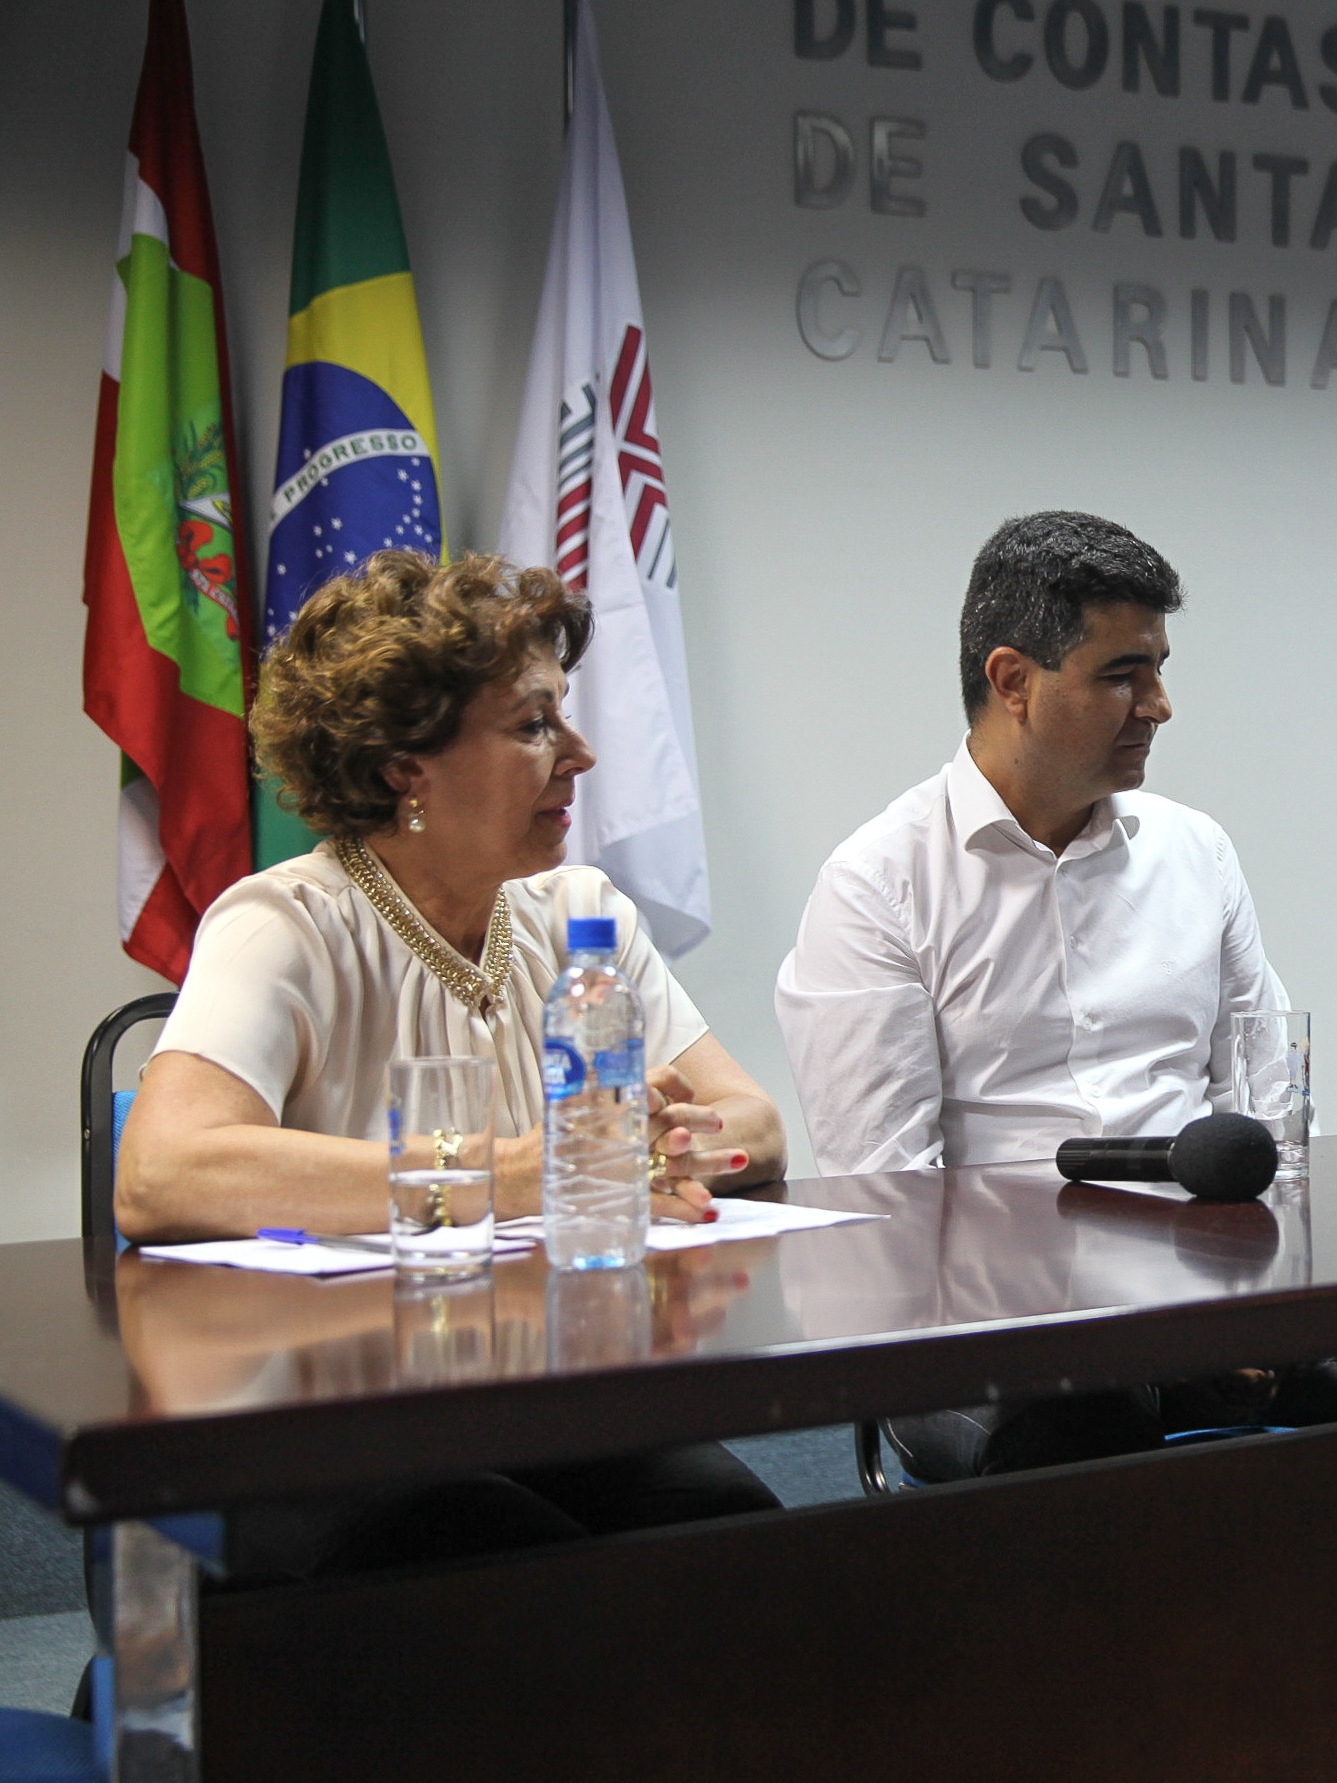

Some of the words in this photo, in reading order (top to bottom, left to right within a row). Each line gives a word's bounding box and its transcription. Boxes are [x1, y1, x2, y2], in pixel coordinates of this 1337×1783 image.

[793, 0, 923, 71] DE
[793, 110, 928, 218] DE
[283, 434, 417, 503] PROGRESSO
